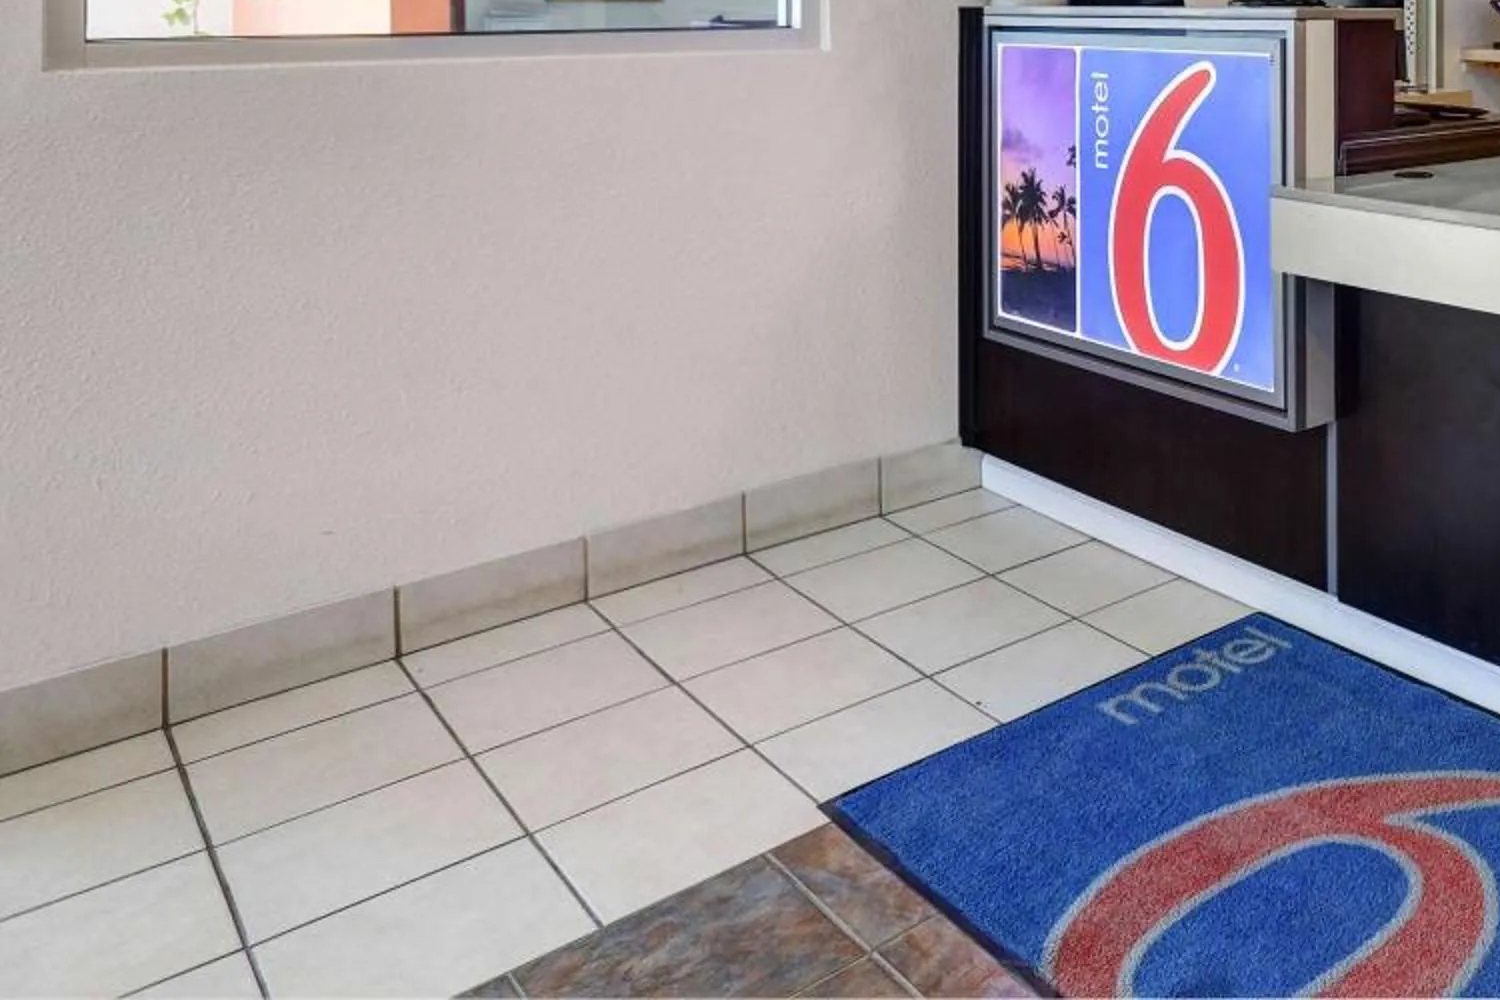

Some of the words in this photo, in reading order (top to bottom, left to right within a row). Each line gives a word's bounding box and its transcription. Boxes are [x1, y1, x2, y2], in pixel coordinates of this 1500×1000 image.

[1091, 71, 1110, 169] motel
[1107, 60, 1245, 375] 6
[1096, 626, 1293, 726] motel
